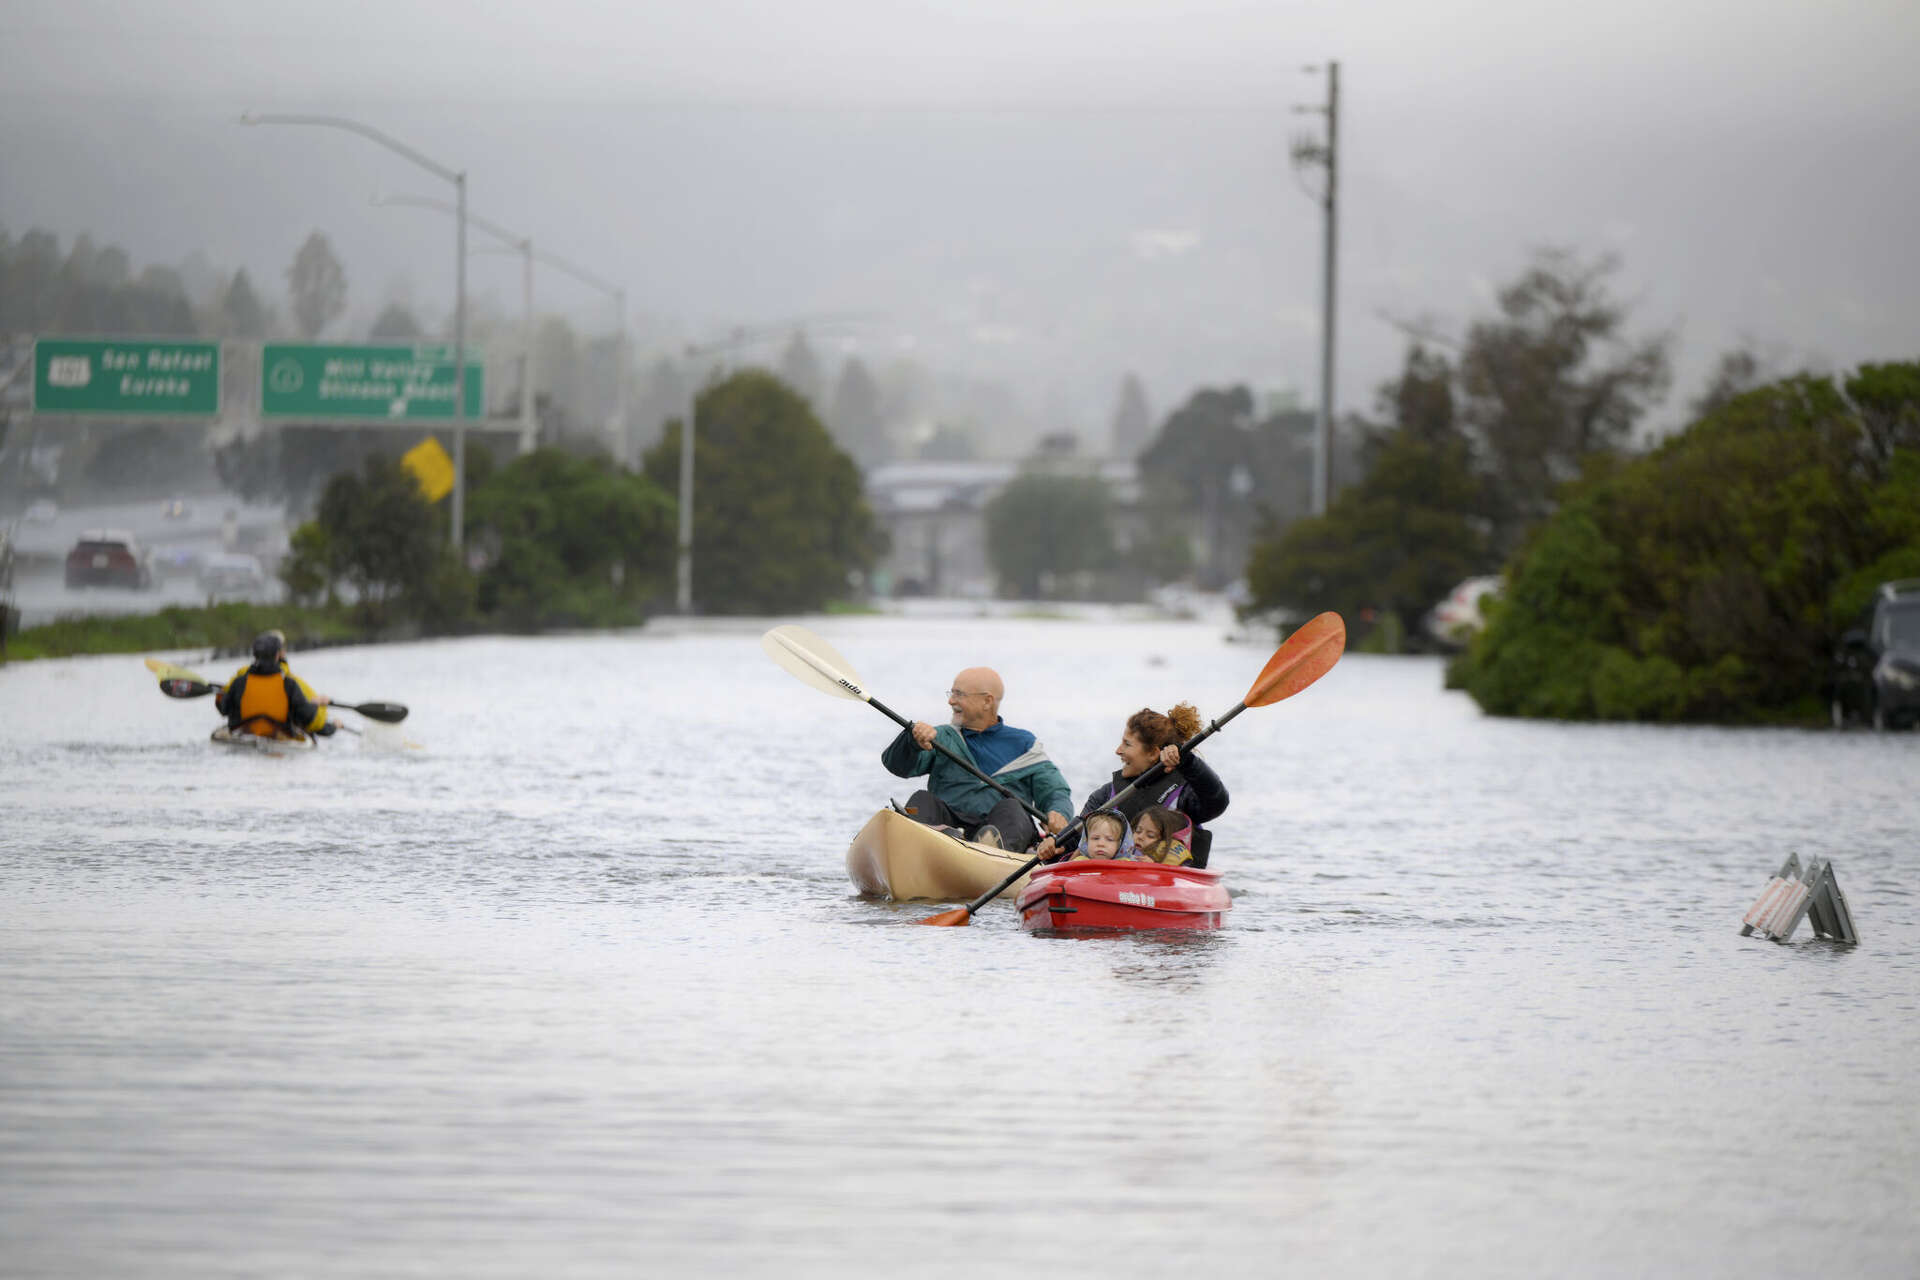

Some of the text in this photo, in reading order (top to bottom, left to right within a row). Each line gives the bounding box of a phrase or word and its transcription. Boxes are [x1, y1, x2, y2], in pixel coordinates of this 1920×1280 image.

[101, 349, 212, 371] San Rafael
[120, 372, 190, 396] Eureka
